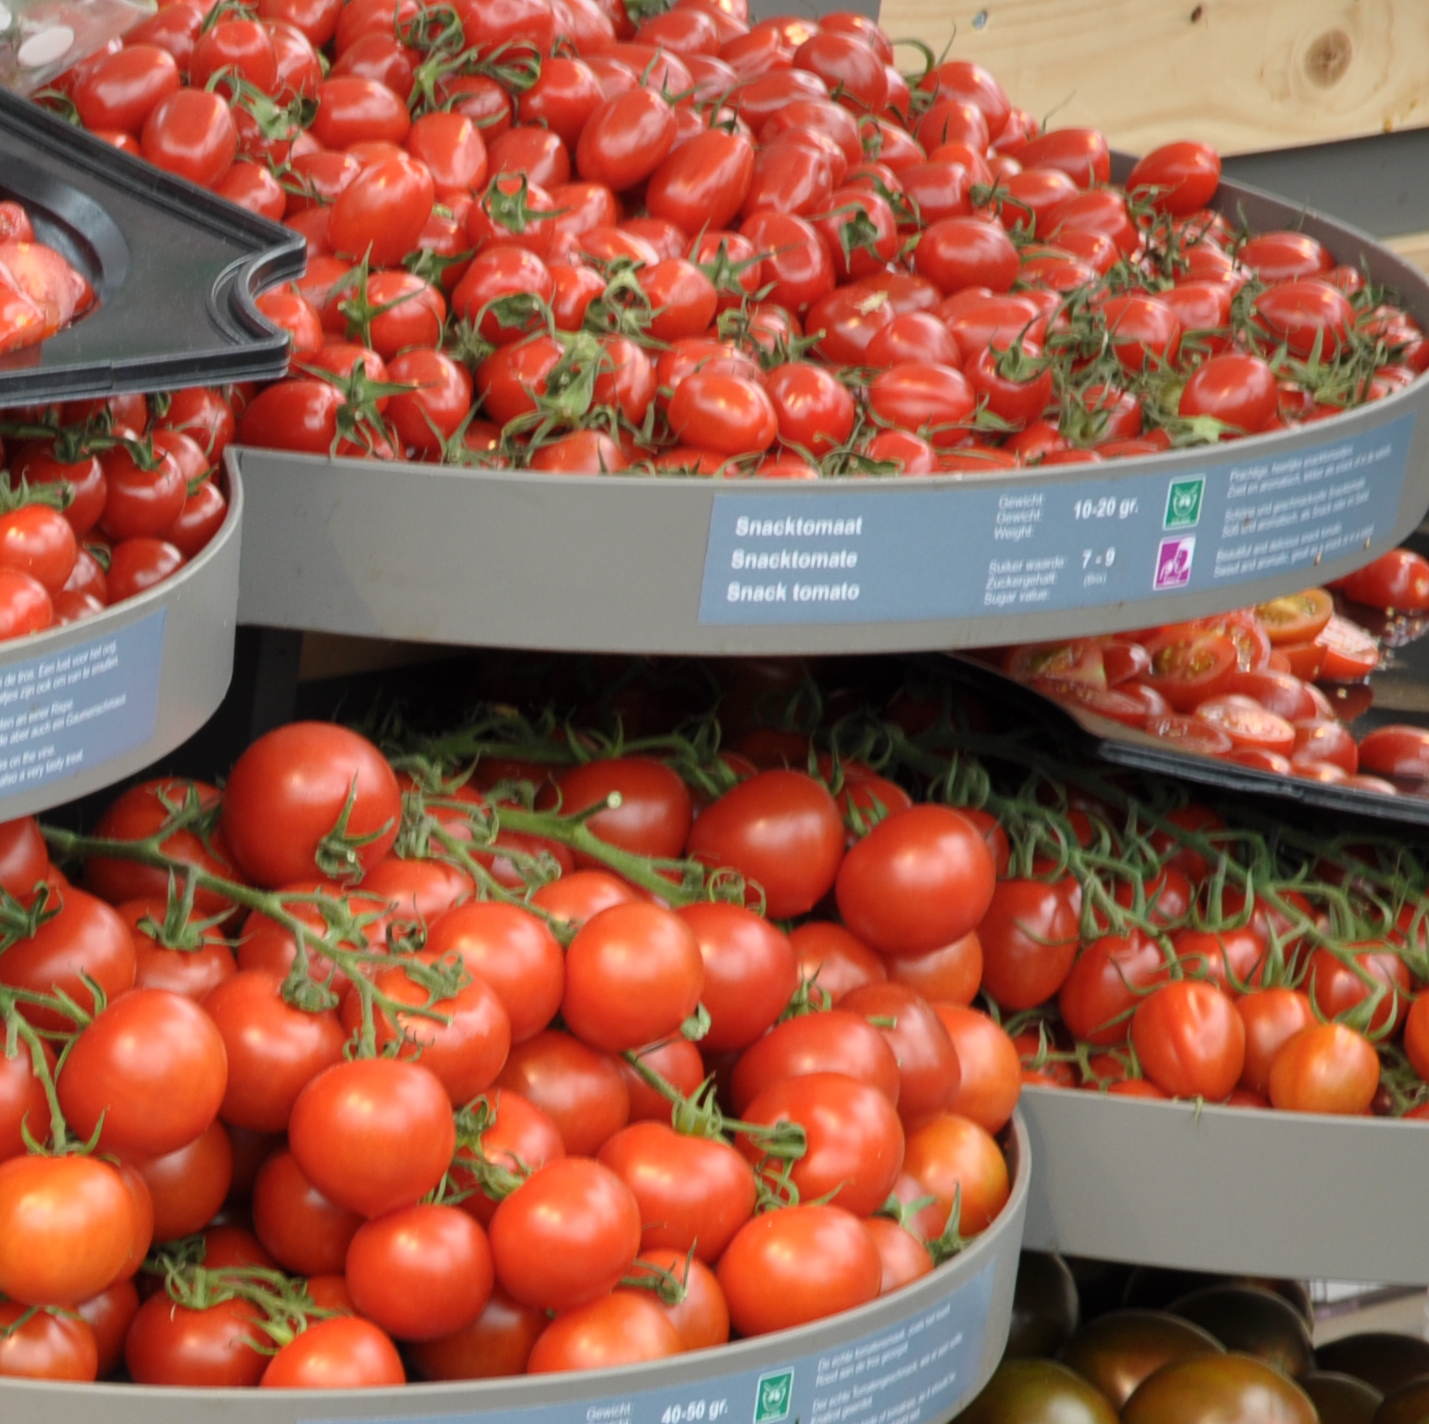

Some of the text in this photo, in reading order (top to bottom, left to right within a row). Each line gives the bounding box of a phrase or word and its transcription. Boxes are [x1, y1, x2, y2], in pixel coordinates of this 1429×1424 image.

[1073, 497, 1139, 520] 10-20 gr.
[734, 516, 863, 537] Snacktomaat
[730, 549, 858, 570] Snacktomate
[1082, 549, 1093, 569] 7
[1104, 546, 1116, 568] 9
[726, 581, 861, 603] Snack tomato
[660, 1399, 729, 1424] 40-50 gr.
